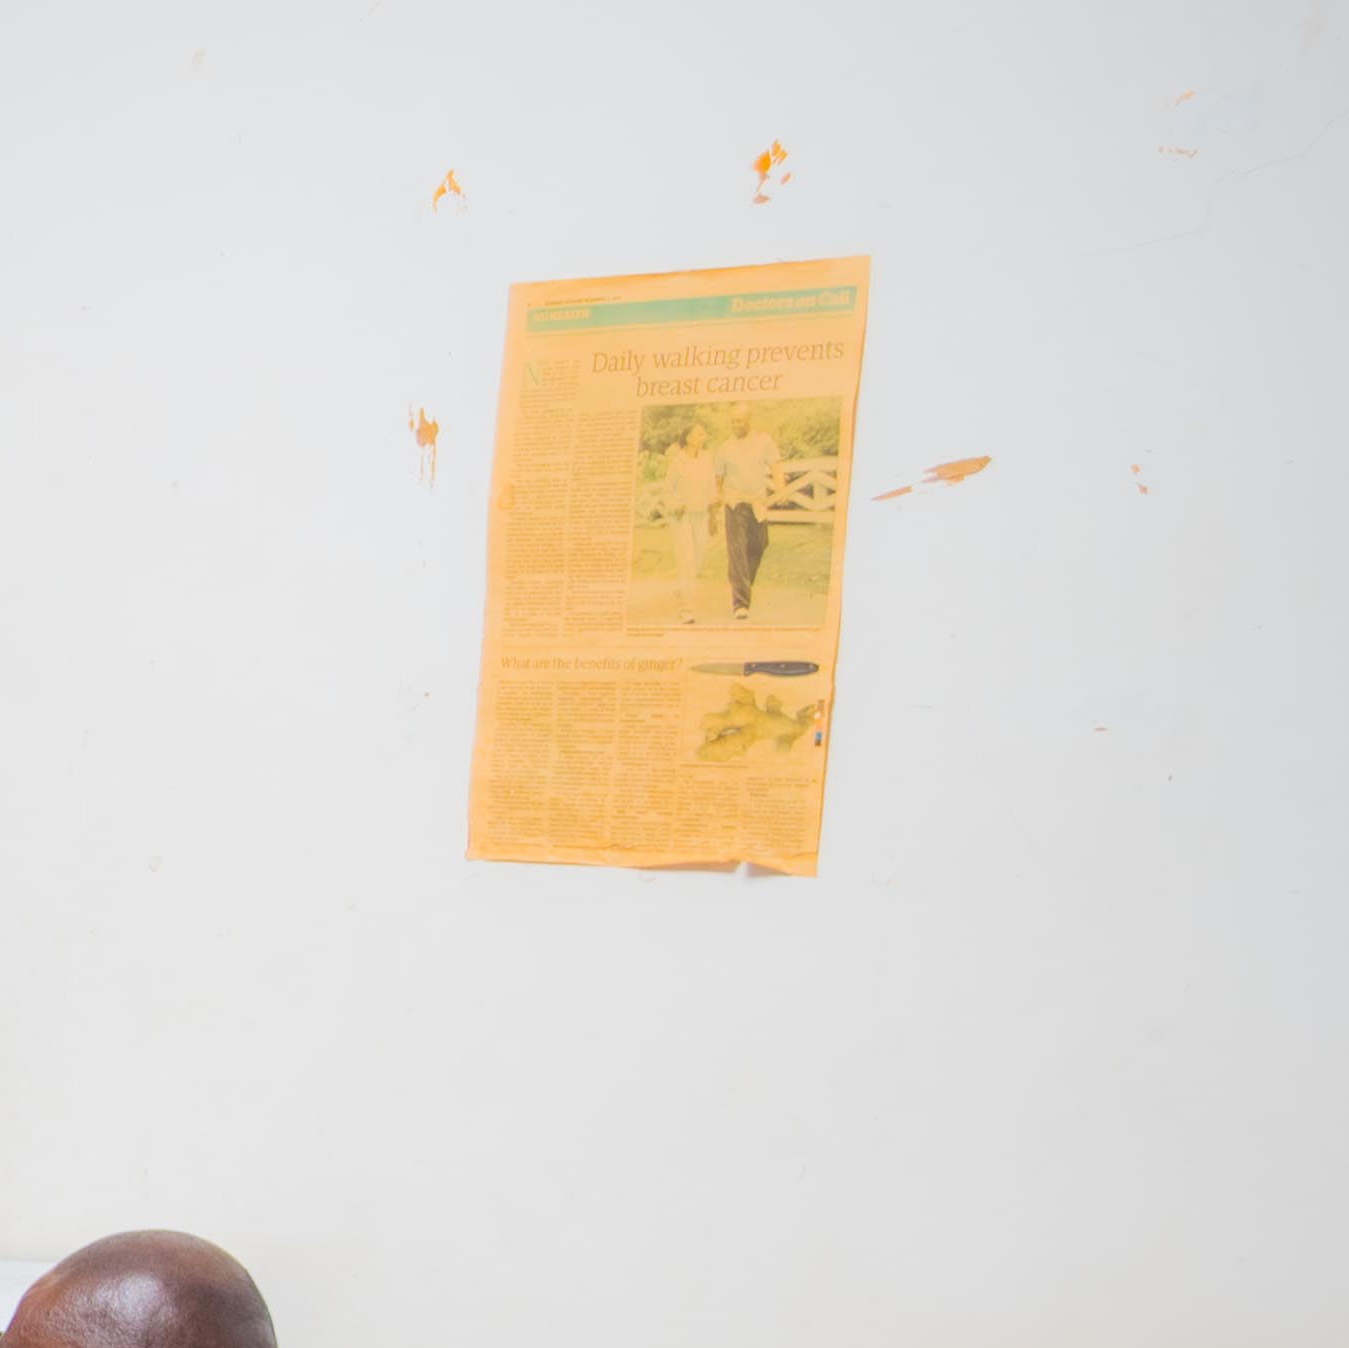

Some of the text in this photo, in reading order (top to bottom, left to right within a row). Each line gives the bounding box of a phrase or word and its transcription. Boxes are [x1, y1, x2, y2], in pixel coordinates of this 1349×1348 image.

[592, 339, 845, 375] Daily walking prevents
[636, 372, 784, 398] breast cancer
